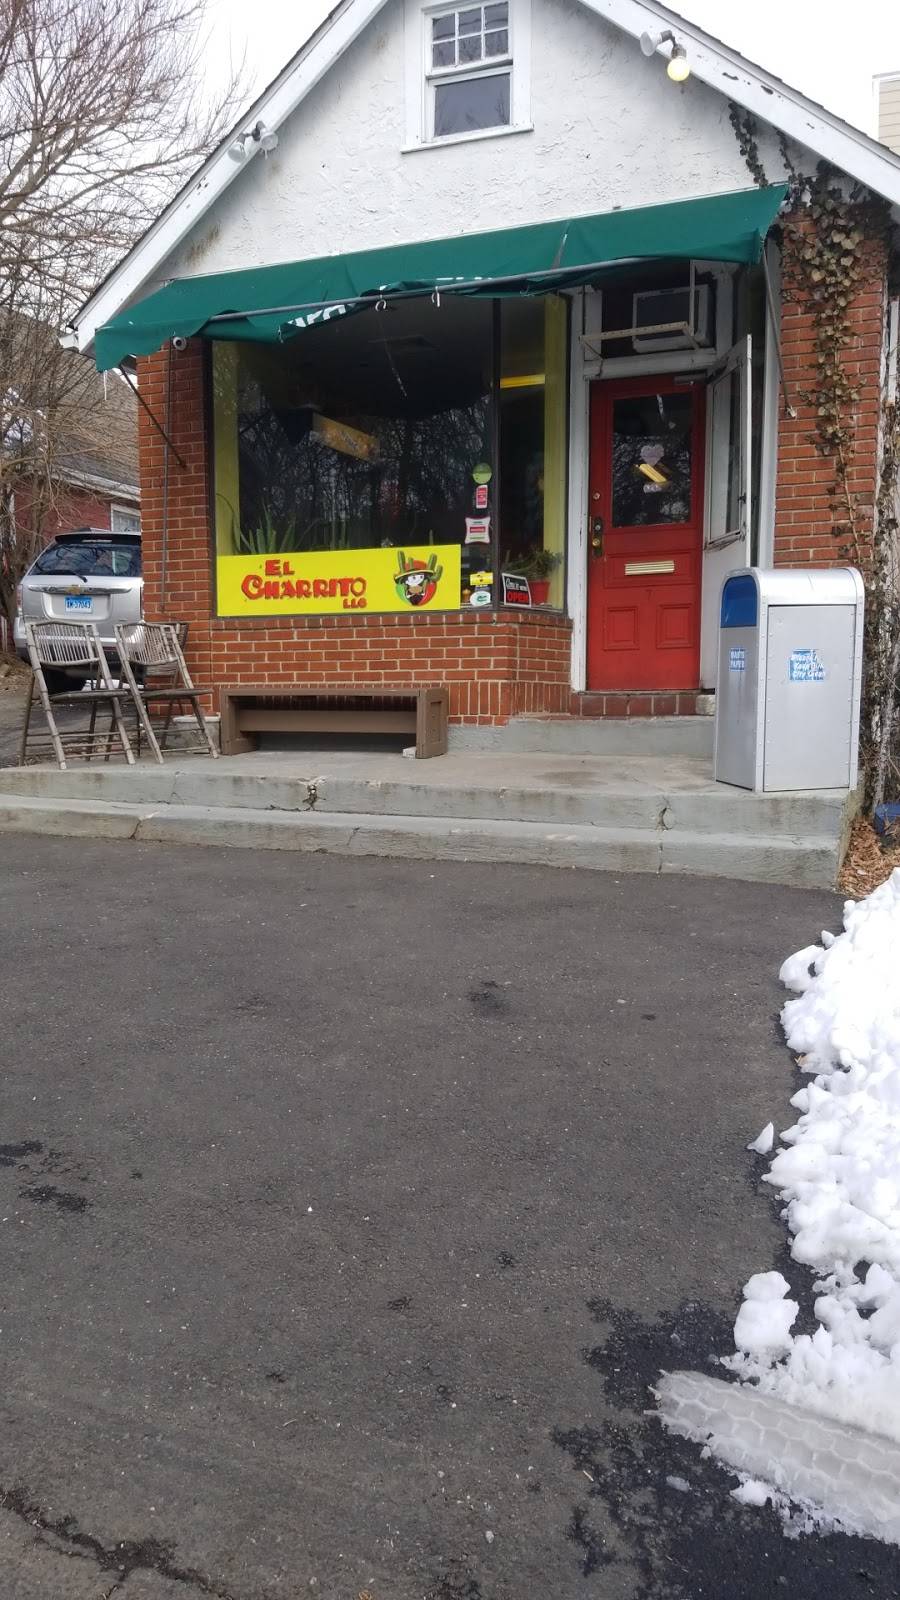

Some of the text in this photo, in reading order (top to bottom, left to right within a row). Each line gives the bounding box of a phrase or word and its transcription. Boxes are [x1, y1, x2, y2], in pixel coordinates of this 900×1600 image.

[264, 559, 295, 576] EL
[241, 574, 367, 600] CHARRITO
[506, 591, 529, 603] OPEN
[343, 598, 367, 609] LLC
[730, 660, 745, 668] PAPER
